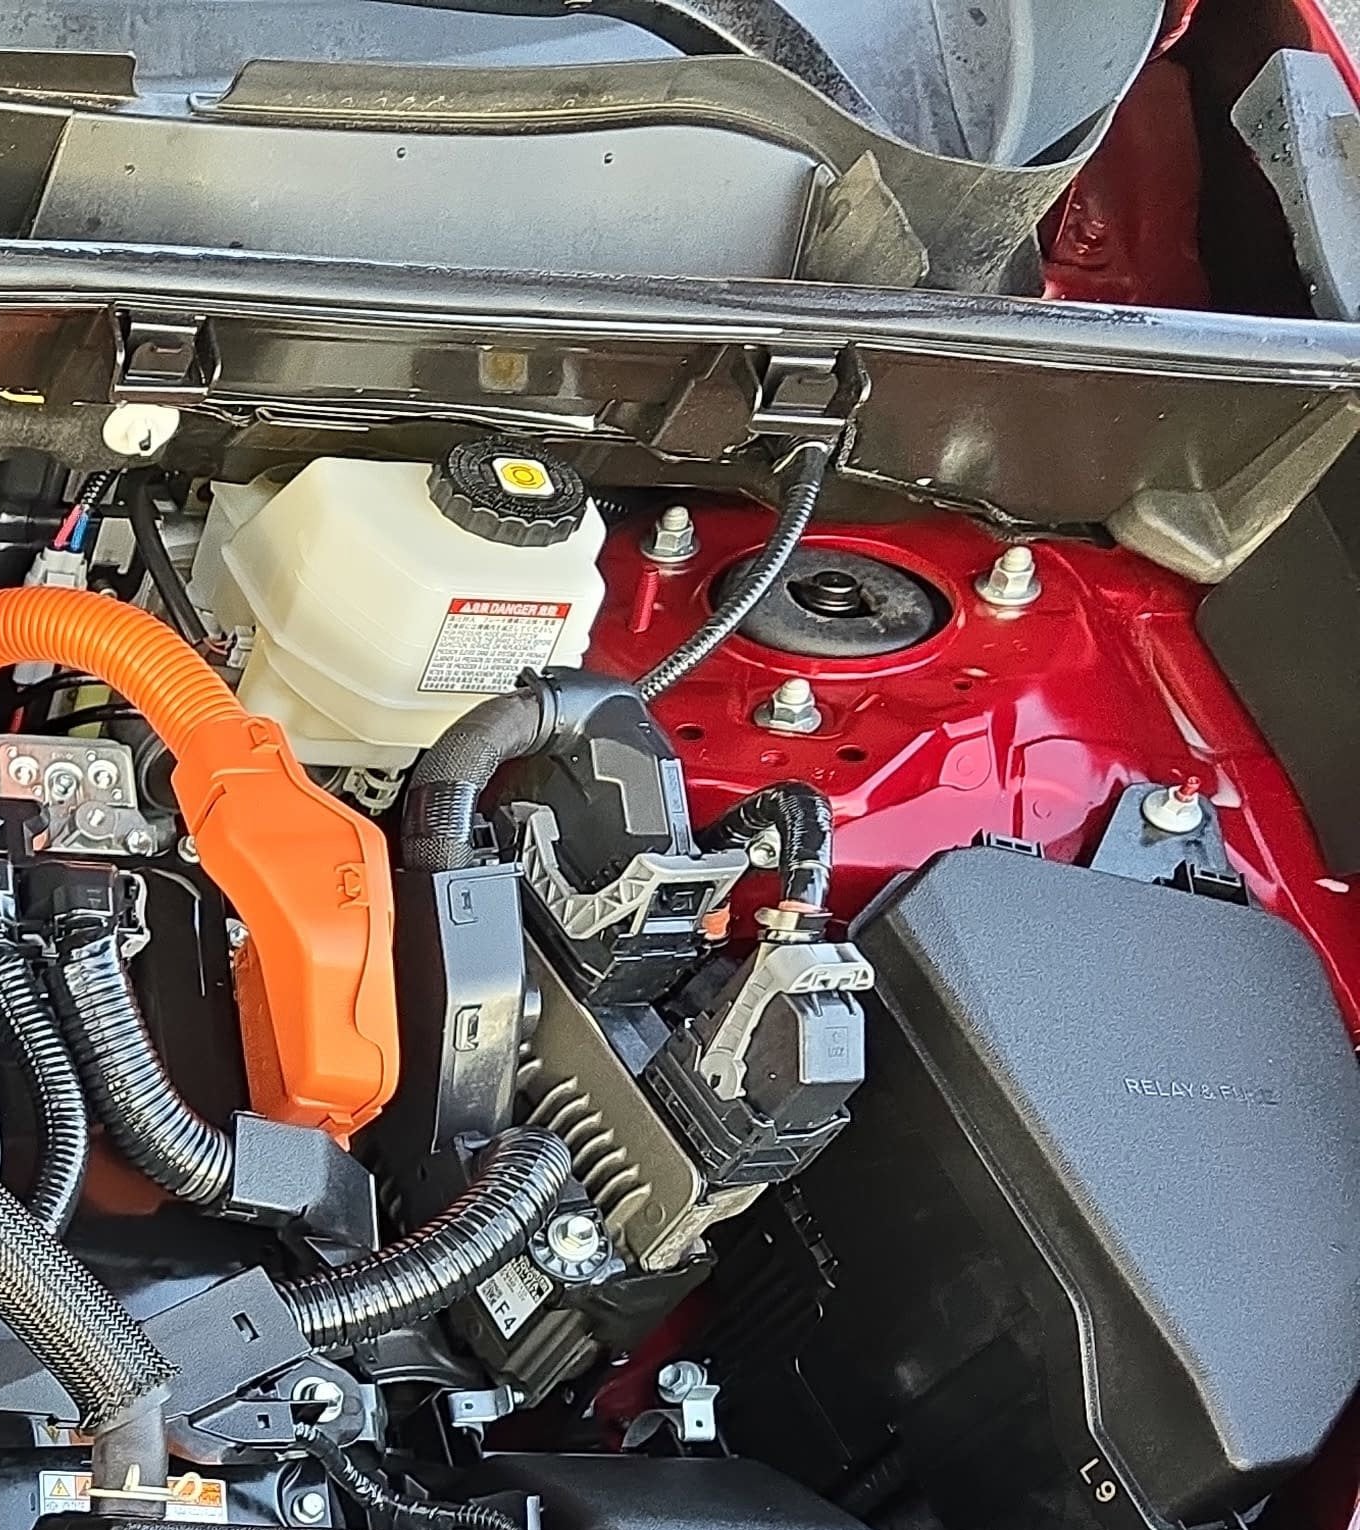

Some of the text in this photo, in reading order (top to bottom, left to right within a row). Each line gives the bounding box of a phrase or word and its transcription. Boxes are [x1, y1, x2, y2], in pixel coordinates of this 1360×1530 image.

[490, 603, 538, 617] DANGER
[1123, 1077, 1194, 1098] RELAY
[1199, 1083, 1216, 1100] &
[1079, 1457, 1116, 1502] L9
